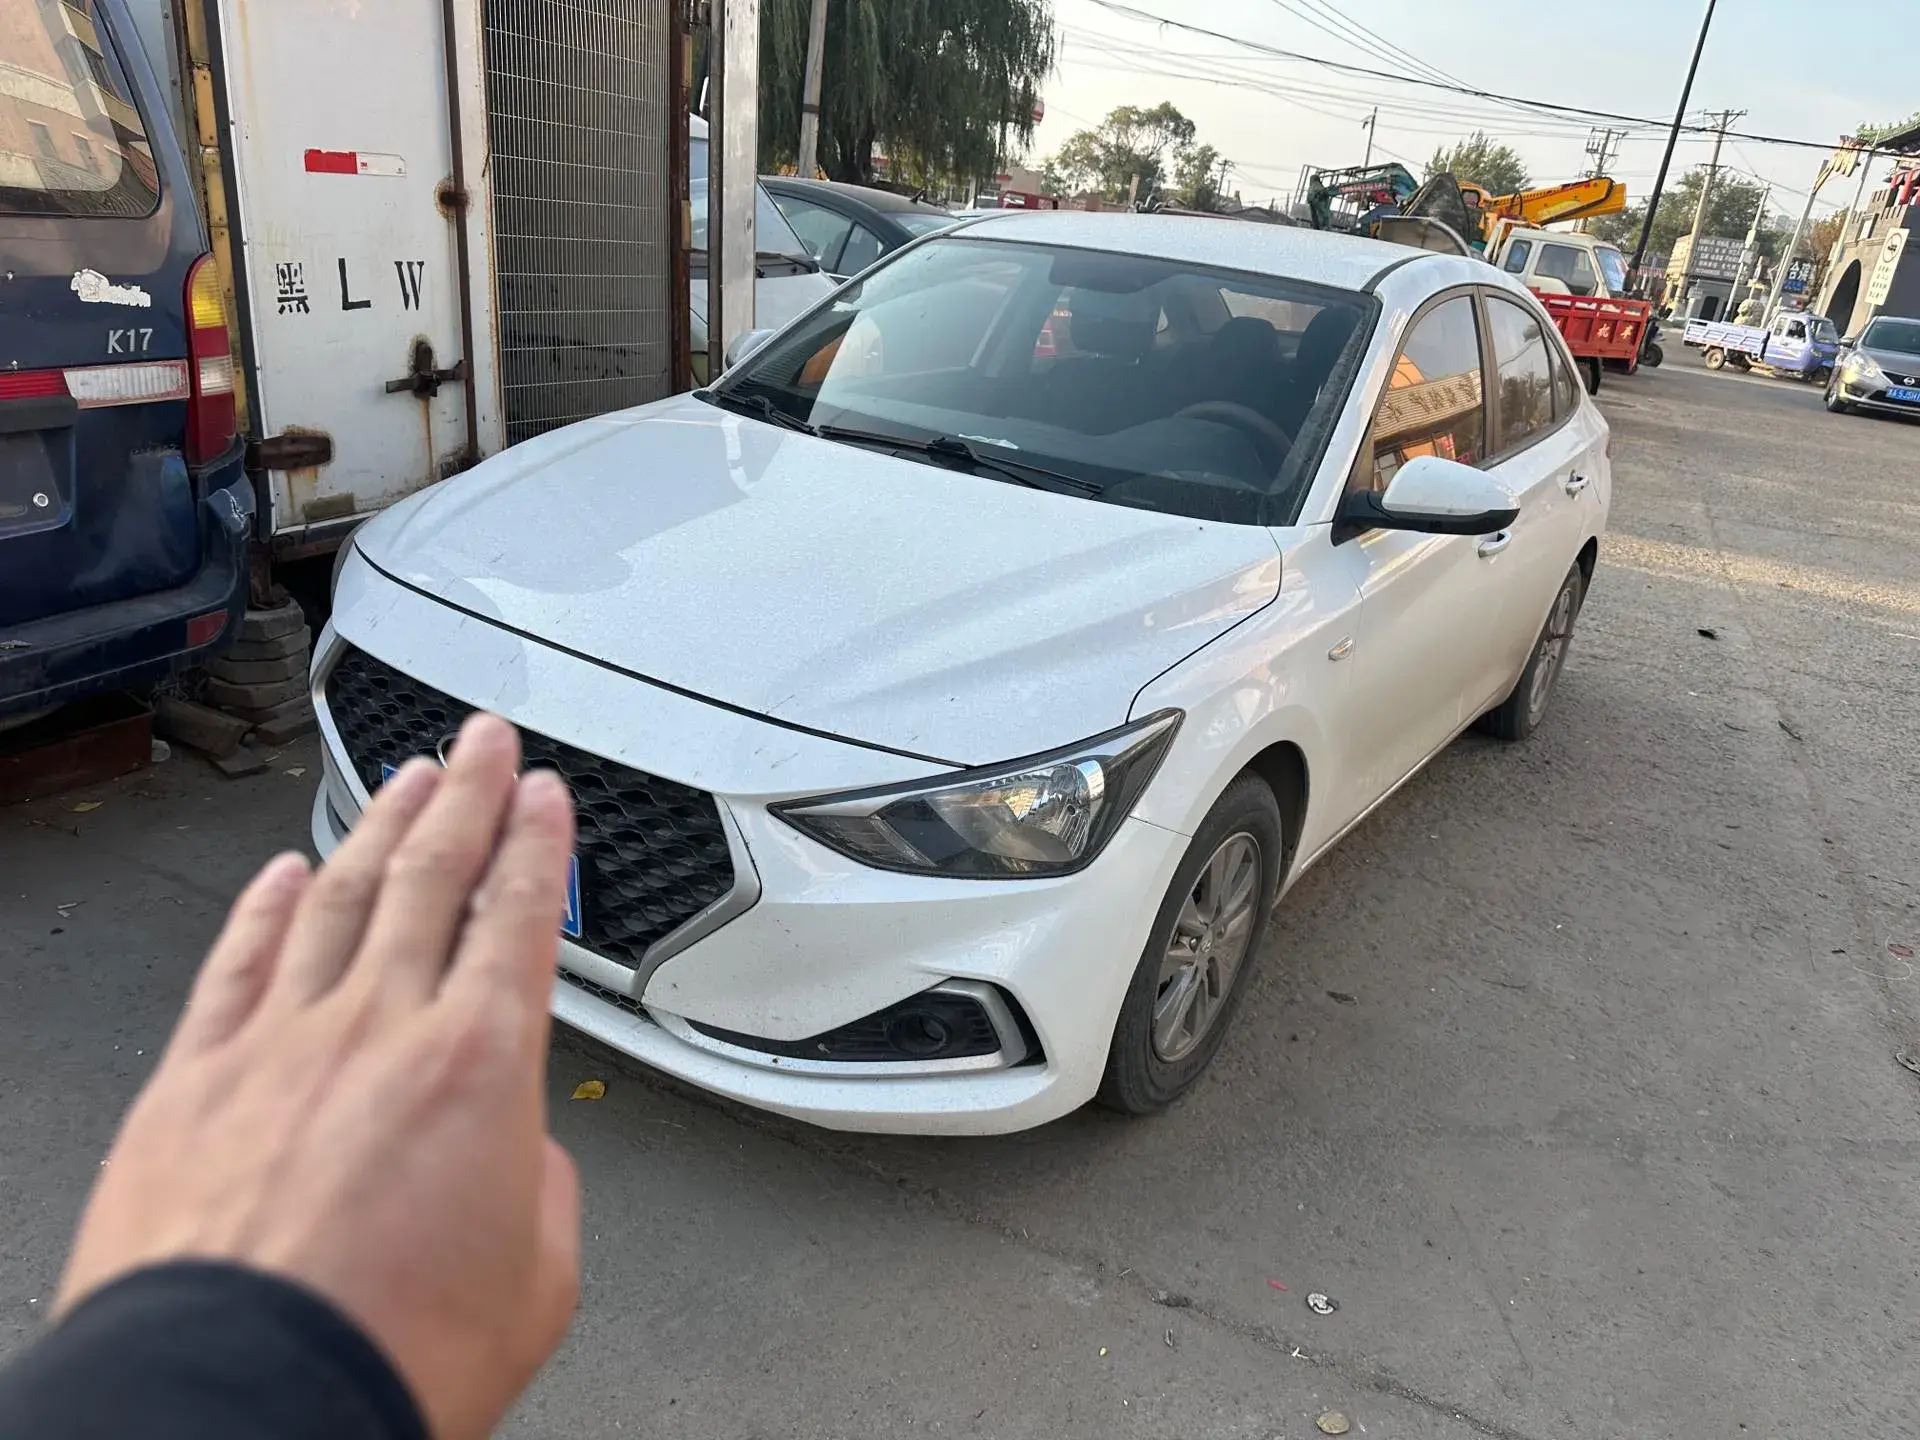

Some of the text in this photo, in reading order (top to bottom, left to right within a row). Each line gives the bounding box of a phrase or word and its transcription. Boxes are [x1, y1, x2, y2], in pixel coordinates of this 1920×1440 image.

[276, 258, 425, 315] 黑 L W
[107, 328, 153, 354] K17
